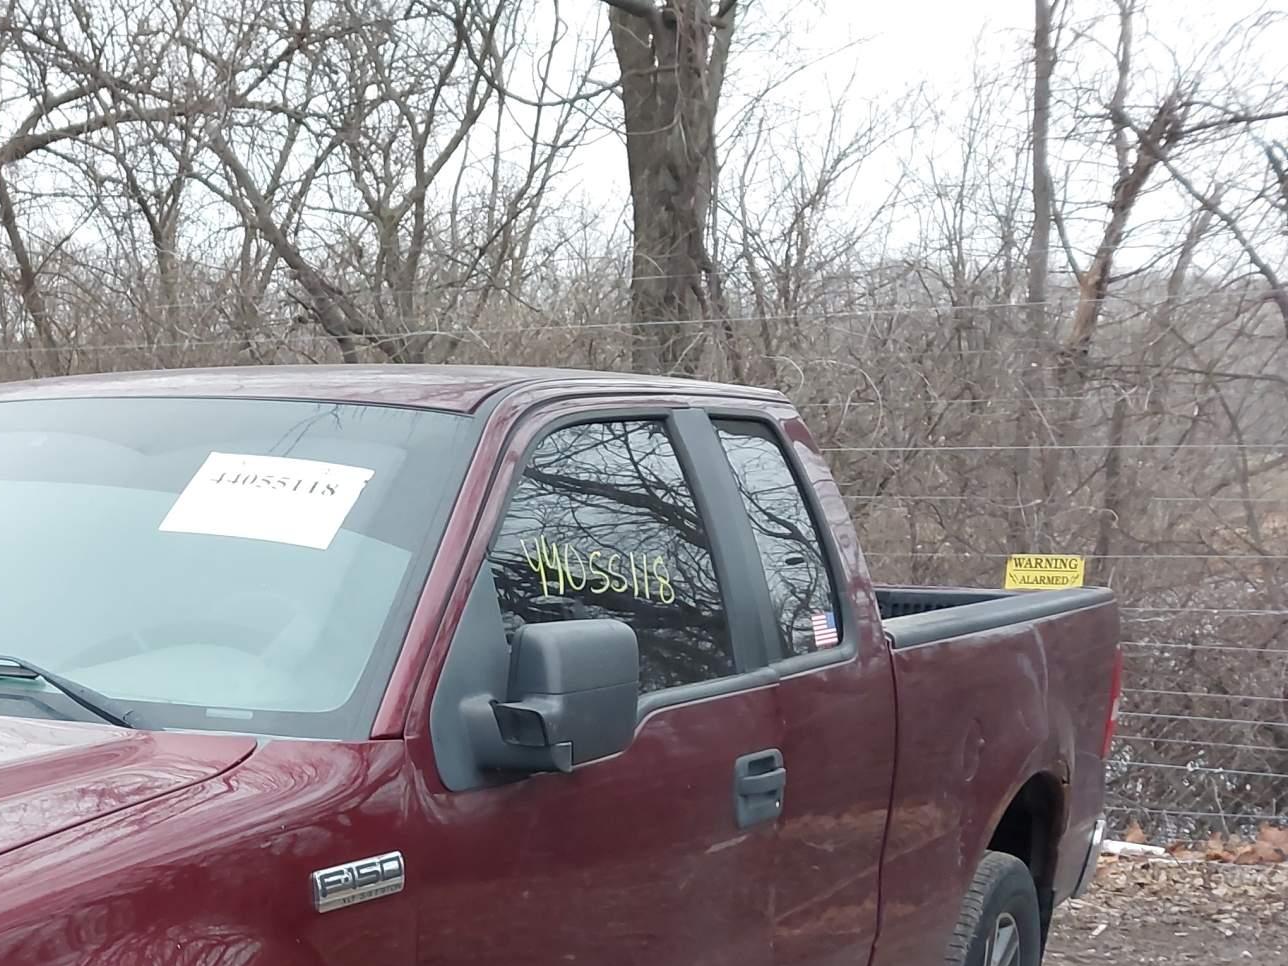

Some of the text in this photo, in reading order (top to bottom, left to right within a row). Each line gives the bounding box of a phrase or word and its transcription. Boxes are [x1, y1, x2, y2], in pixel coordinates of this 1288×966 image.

[211, 471, 339, 497] 44055118
[520, 534, 675, 604] 44055118
[1013, 557, 1079, 570] WARNING
[1019, 575, 1069, 585] ALARMED
